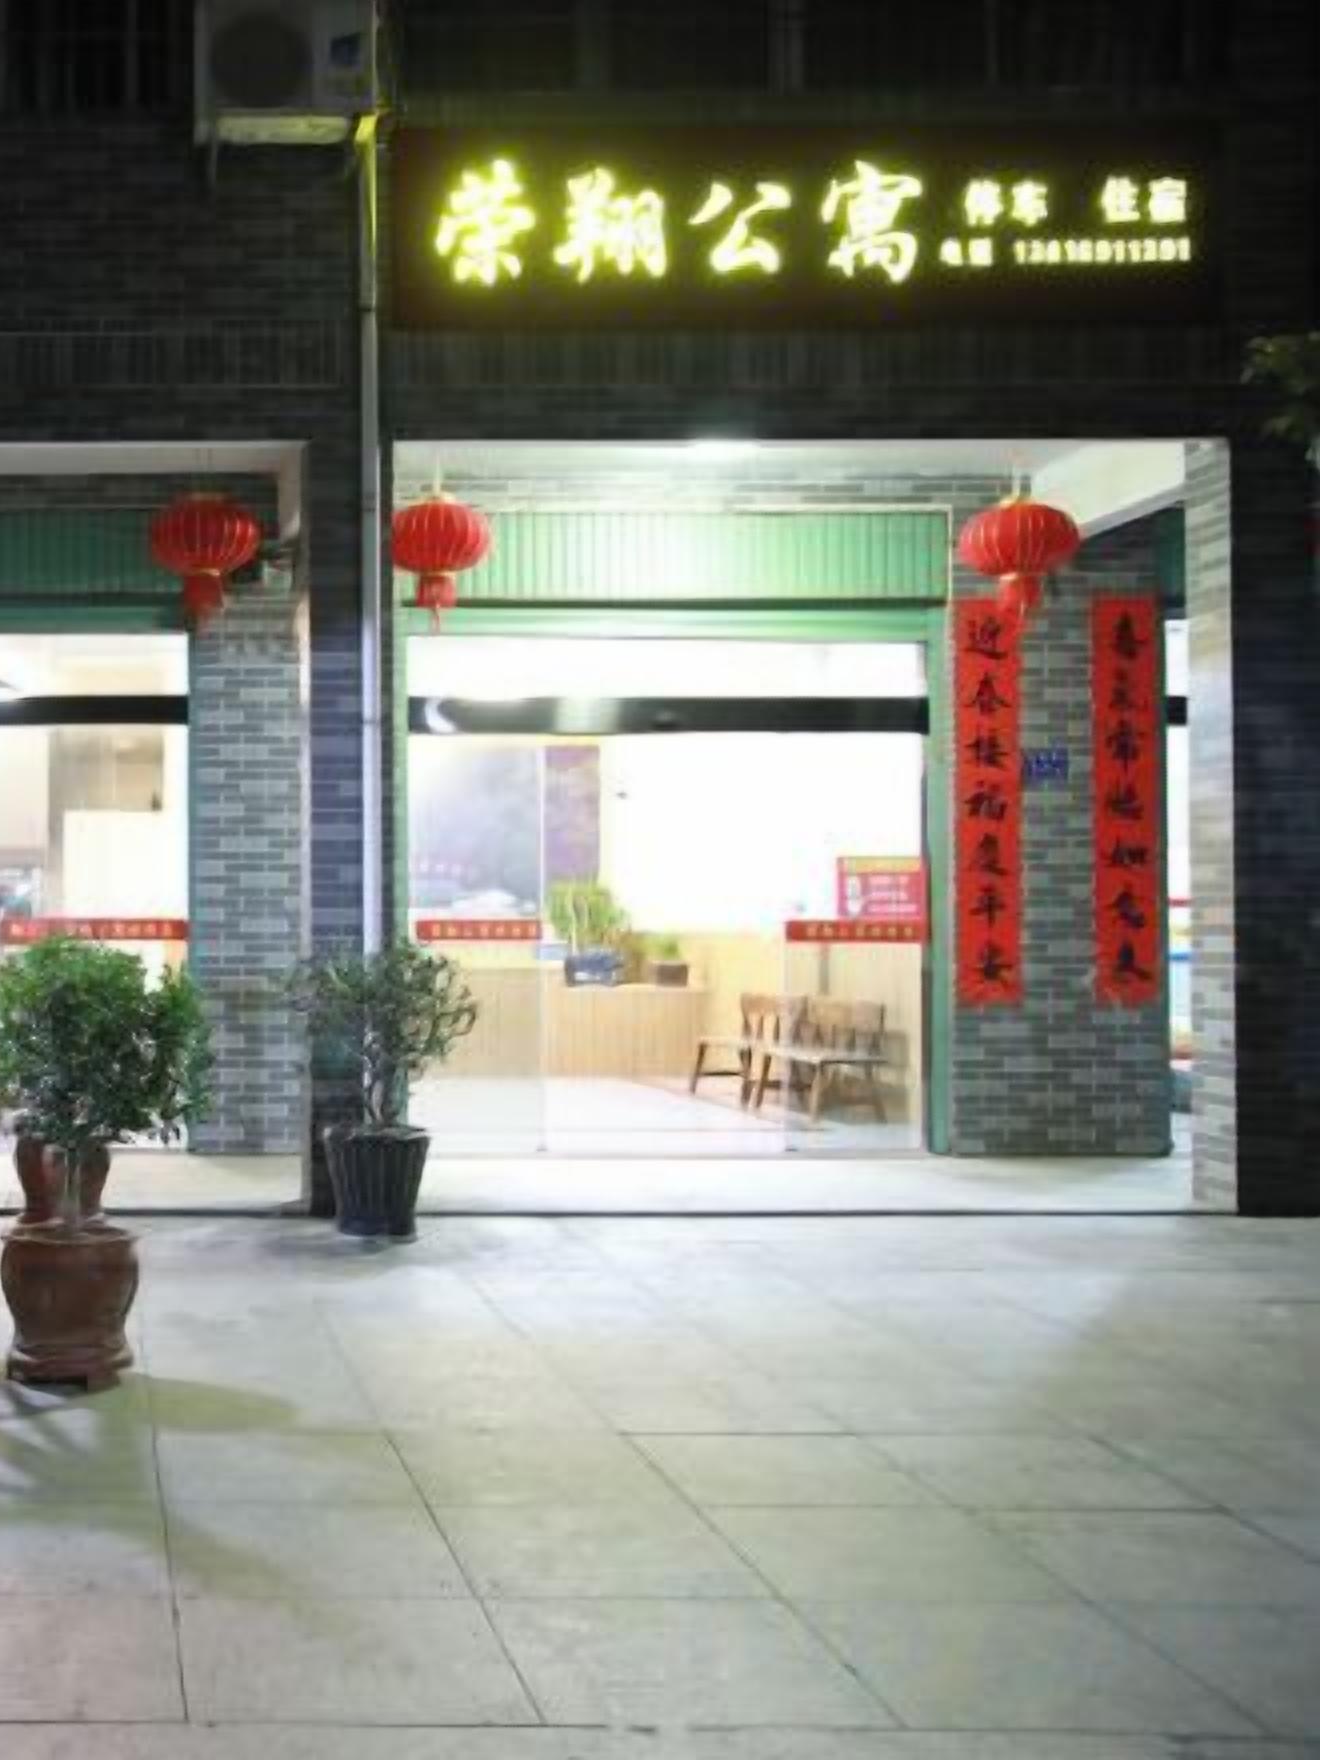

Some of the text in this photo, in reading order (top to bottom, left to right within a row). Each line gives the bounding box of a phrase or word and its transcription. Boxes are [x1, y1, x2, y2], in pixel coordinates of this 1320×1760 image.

[435, 159, 921, 284] 荣翔公寓
[1100, 177, 1188, 224] 住宿
